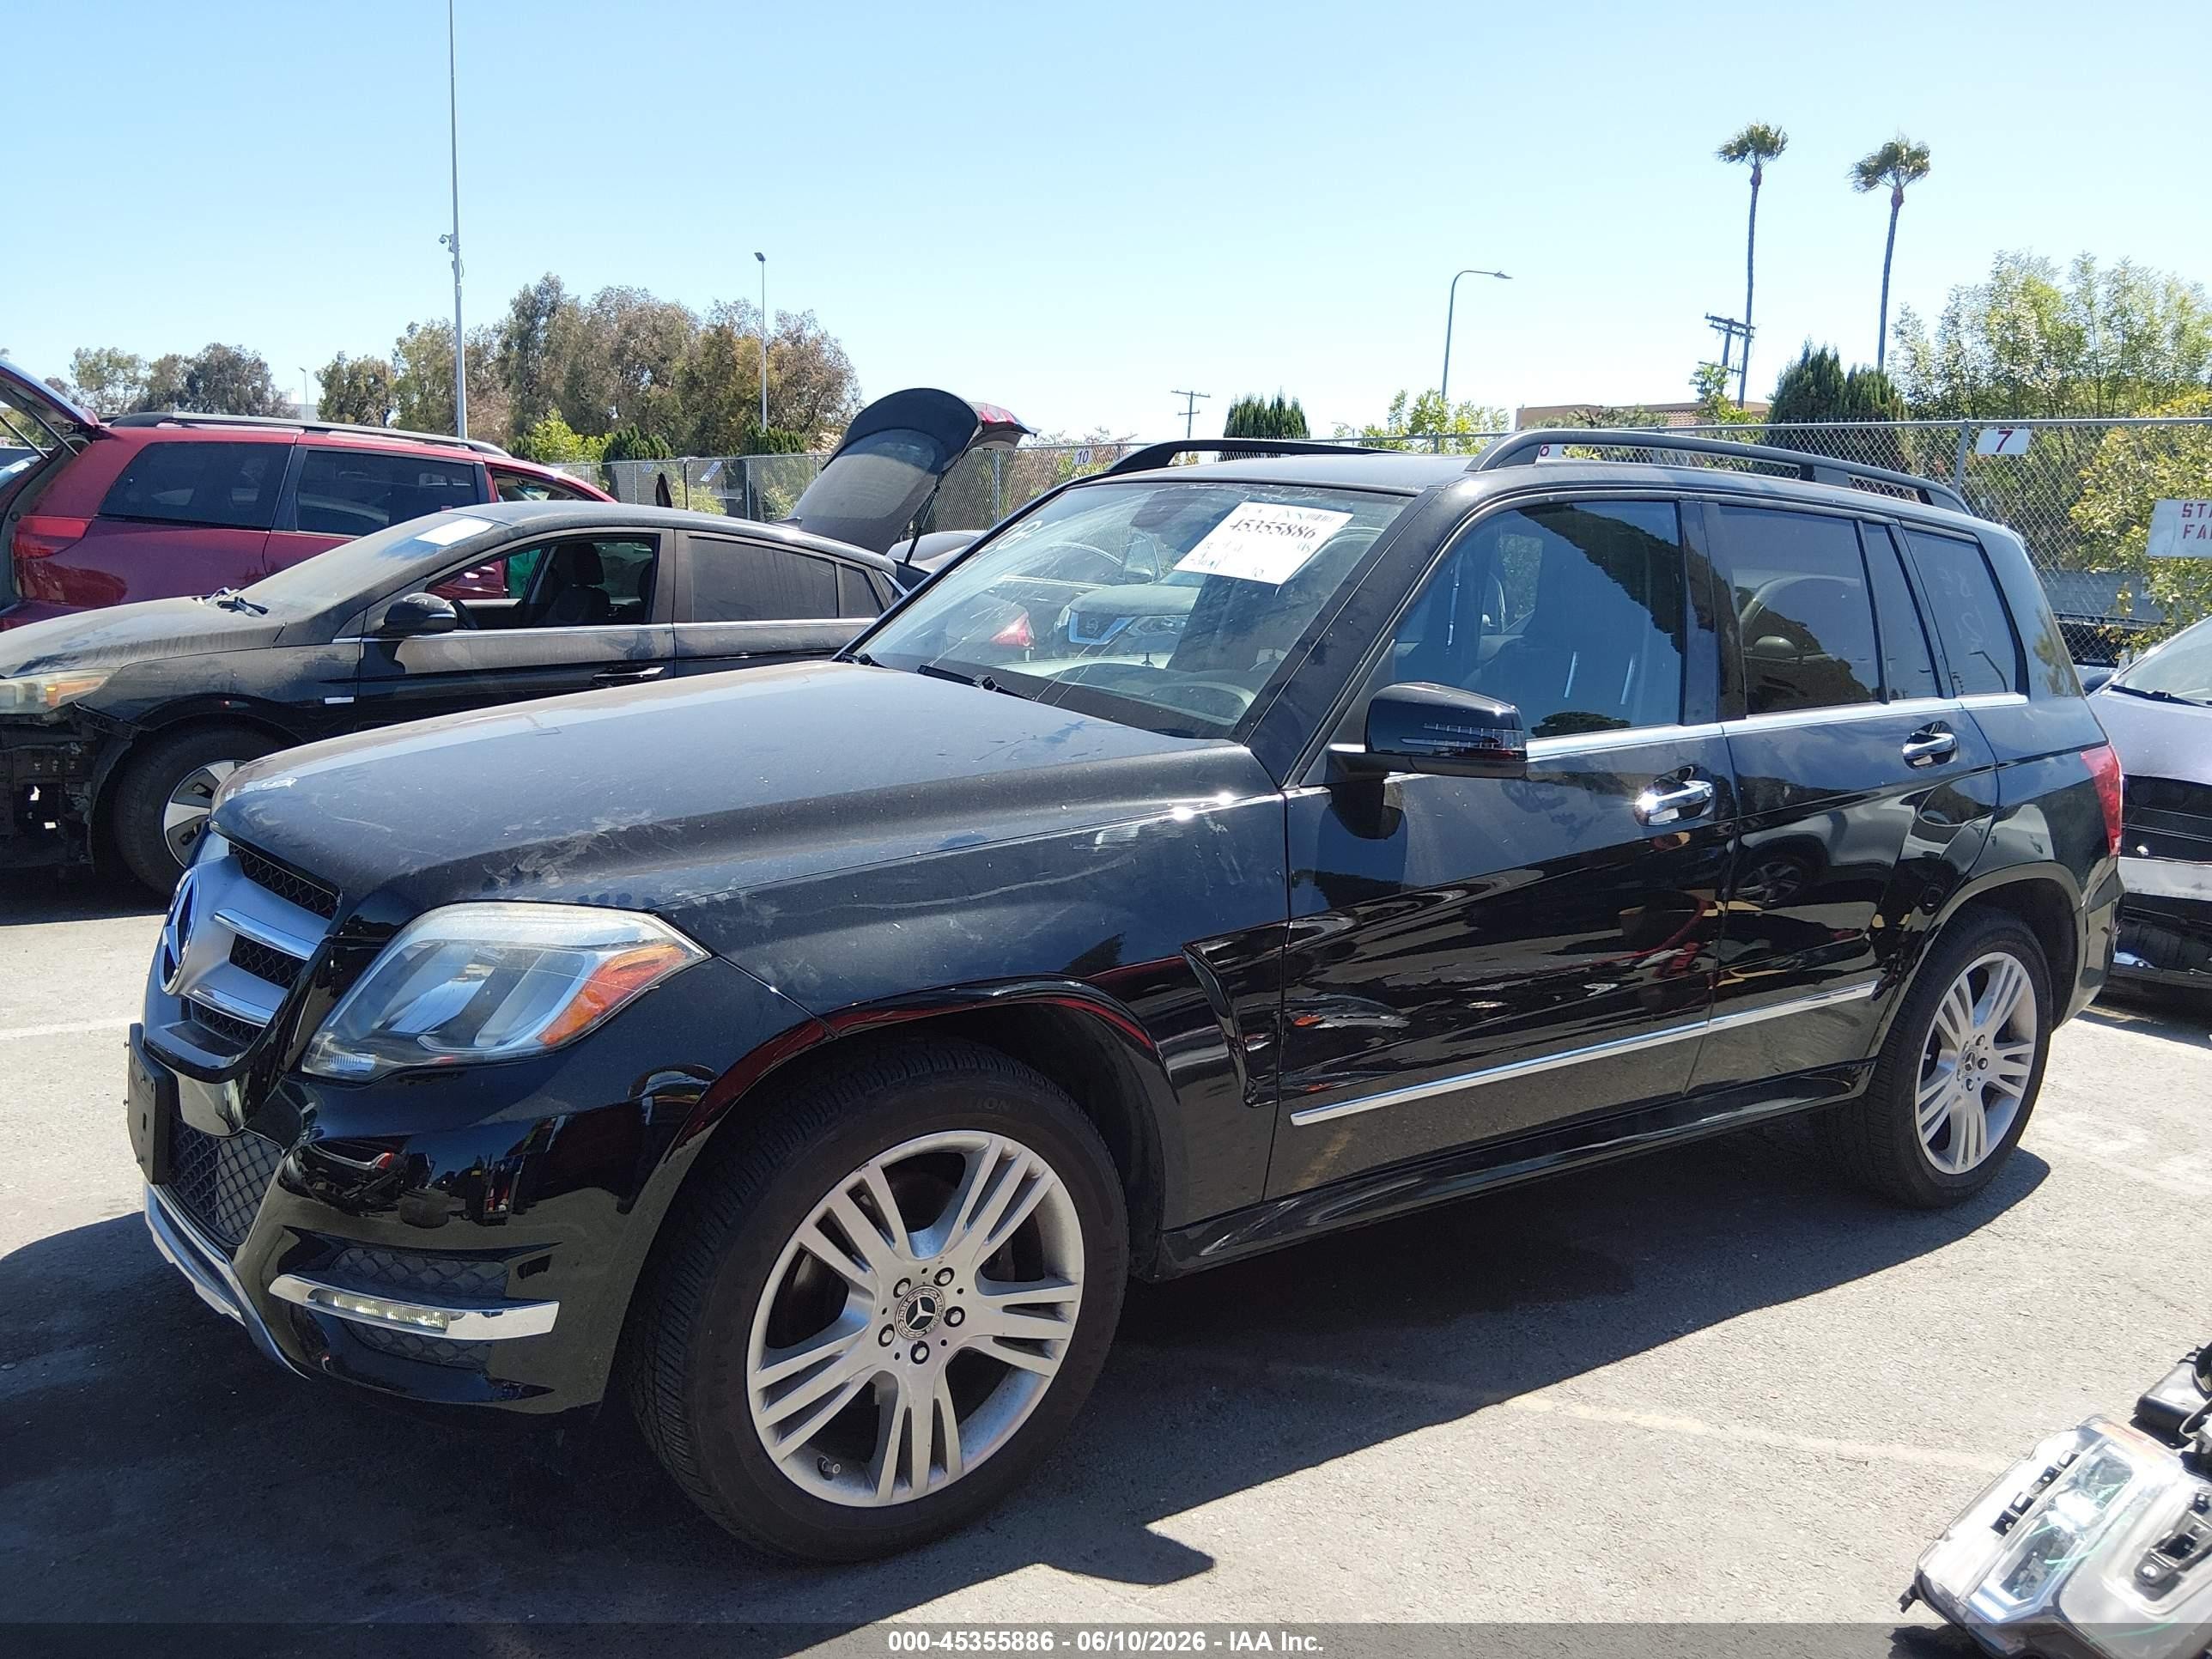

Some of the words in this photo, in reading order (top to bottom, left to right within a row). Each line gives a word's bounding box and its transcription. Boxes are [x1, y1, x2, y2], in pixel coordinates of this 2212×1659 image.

[1996, 430, 2014, 453] 7
[1078, 450, 1090, 465] 10
[1230, 518, 1318, 539] 45355886
[2183, 524, 2212, 539] FA
